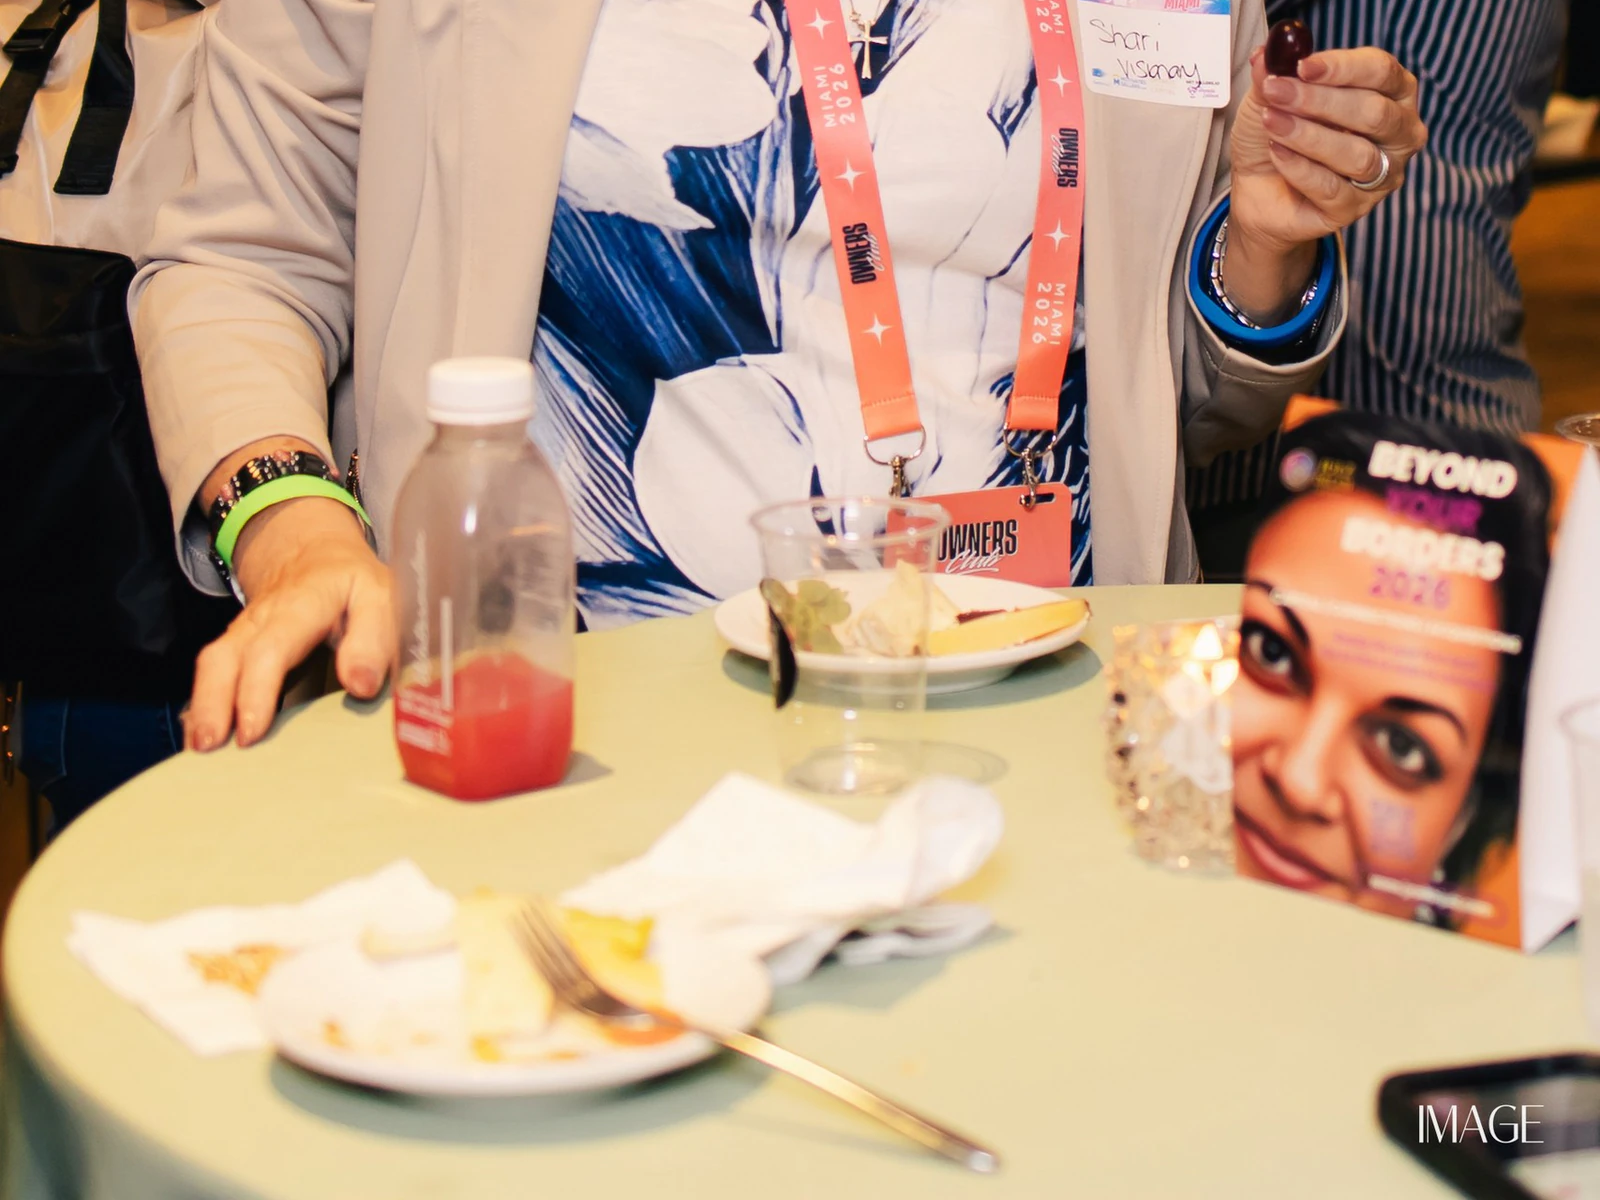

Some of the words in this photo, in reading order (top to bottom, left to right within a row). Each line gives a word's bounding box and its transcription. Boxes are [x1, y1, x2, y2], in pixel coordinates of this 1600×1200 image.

[1089, 18, 1160, 51] Shari
[813, 66, 836, 128] MIAMI
[829, 63, 855, 125] 2026
[1057, 128, 1079, 187] OWNERS
[842, 222, 877, 285] OWNERS
[1032, 282, 1052, 345] 2026
[1050, 283, 1067, 346] MIAMI
[1367, 439, 1518, 499] BEYOND
[945, 546, 1001, 575] Club
[1340, 516, 1506, 581] BORDERS
[1369, 567, 1450, 610] 2026
